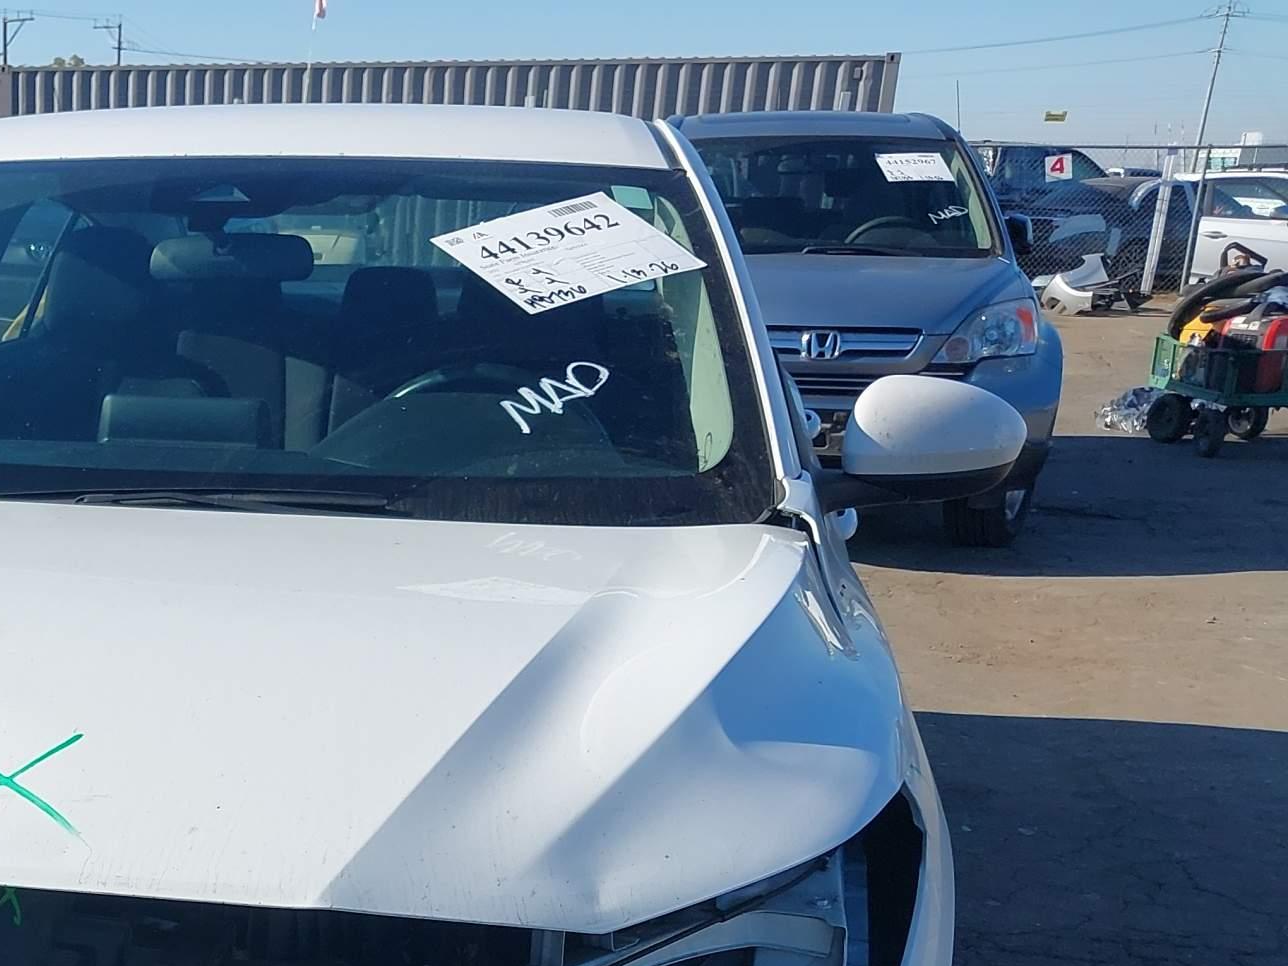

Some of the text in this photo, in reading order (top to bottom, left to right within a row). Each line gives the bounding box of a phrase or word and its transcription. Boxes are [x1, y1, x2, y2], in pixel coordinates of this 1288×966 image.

[1050, 156, 1065, 174] 4
[927, 205, 969, 225] MAD
[480, 214, 620, 261] 44139642
[499, 361, 611, 435] MAD
